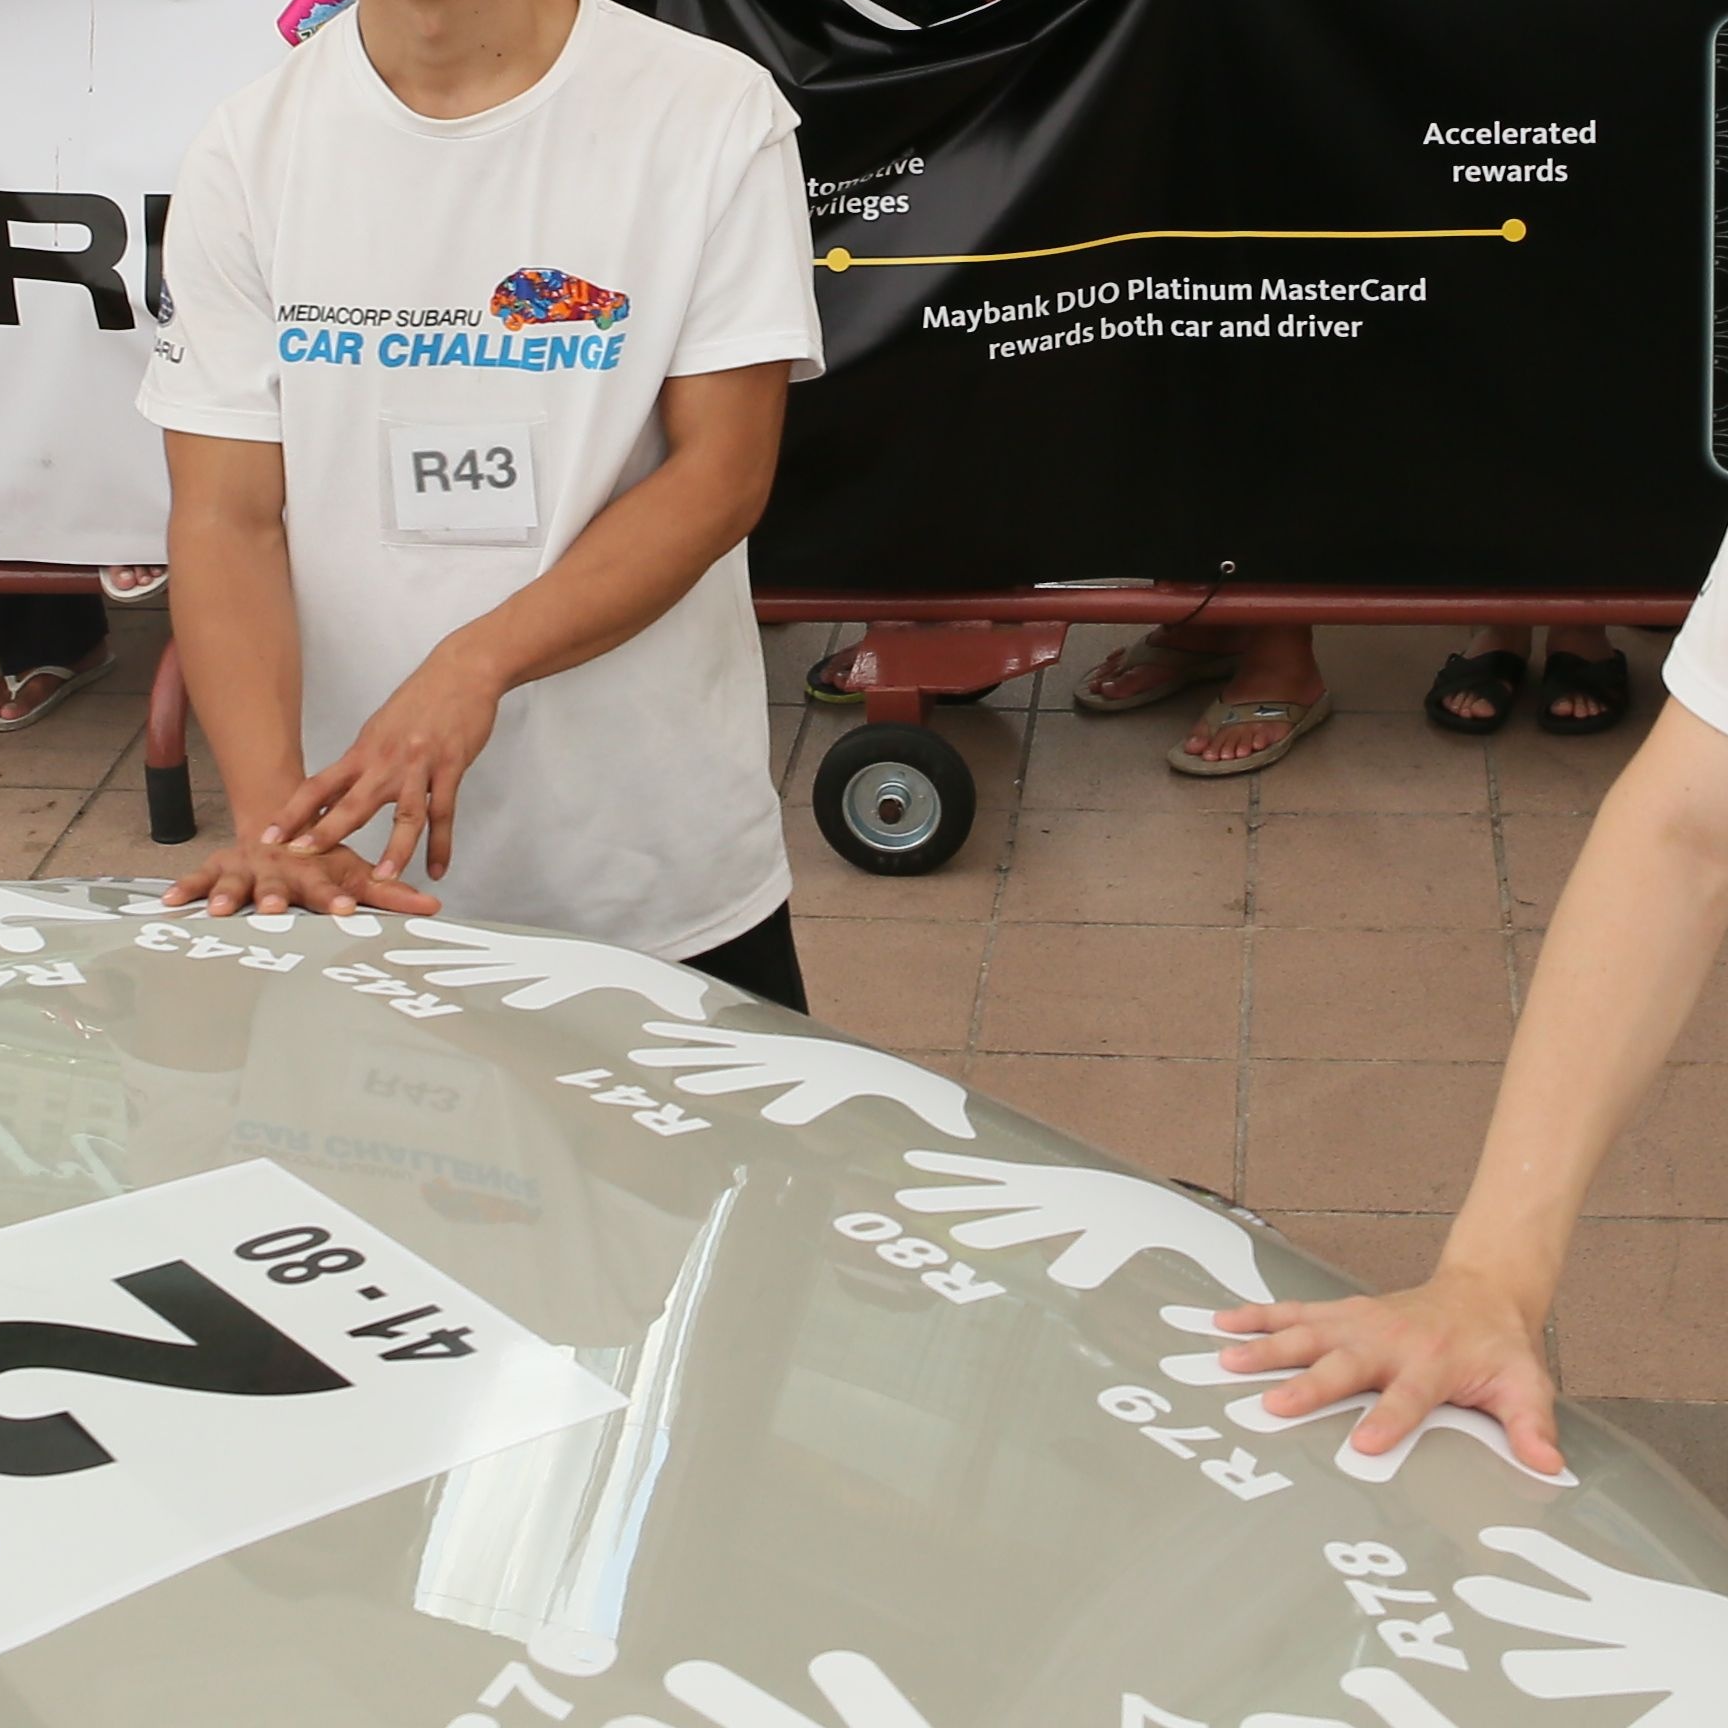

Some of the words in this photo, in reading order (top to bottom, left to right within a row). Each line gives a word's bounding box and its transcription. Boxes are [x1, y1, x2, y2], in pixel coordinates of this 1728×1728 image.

[1422, 119, 1598, 146] Accelerated
[1452, 157, 1569, 184] rewards
[277, 304, 392, 327] MEDIACORP
[394, 308, 483, 328] SUBARU
[922, 293, 1051, 334] Maybank
[1056, 281, 1121, 315] DUO
[1127, 276, 1253, 302] Platinum
[1260, 276, 1427, 302] MasterCard
[278, 327, 364, 365] CAR
[377, 332, 627, 372] CHALLENGE
[988, 321, 1095, 361] rewards
[1100, 312, 1164, 341] both
[1169, 319, 1213, 339] car
[1219, 313, 1271, 339] and
[1276, 313, 1365, 339] driver
[410, 445, 518, 494] R43
[133, 921, 306, 974] R43
[321, 962, 464, 1019] R42
[554, 1068, 713, 1137] R41
[832, 1211, 1007, 1306] R80
[1096, 1384, 1295, 1502] R79
[1322, 1540, 1471, 1672] R78
